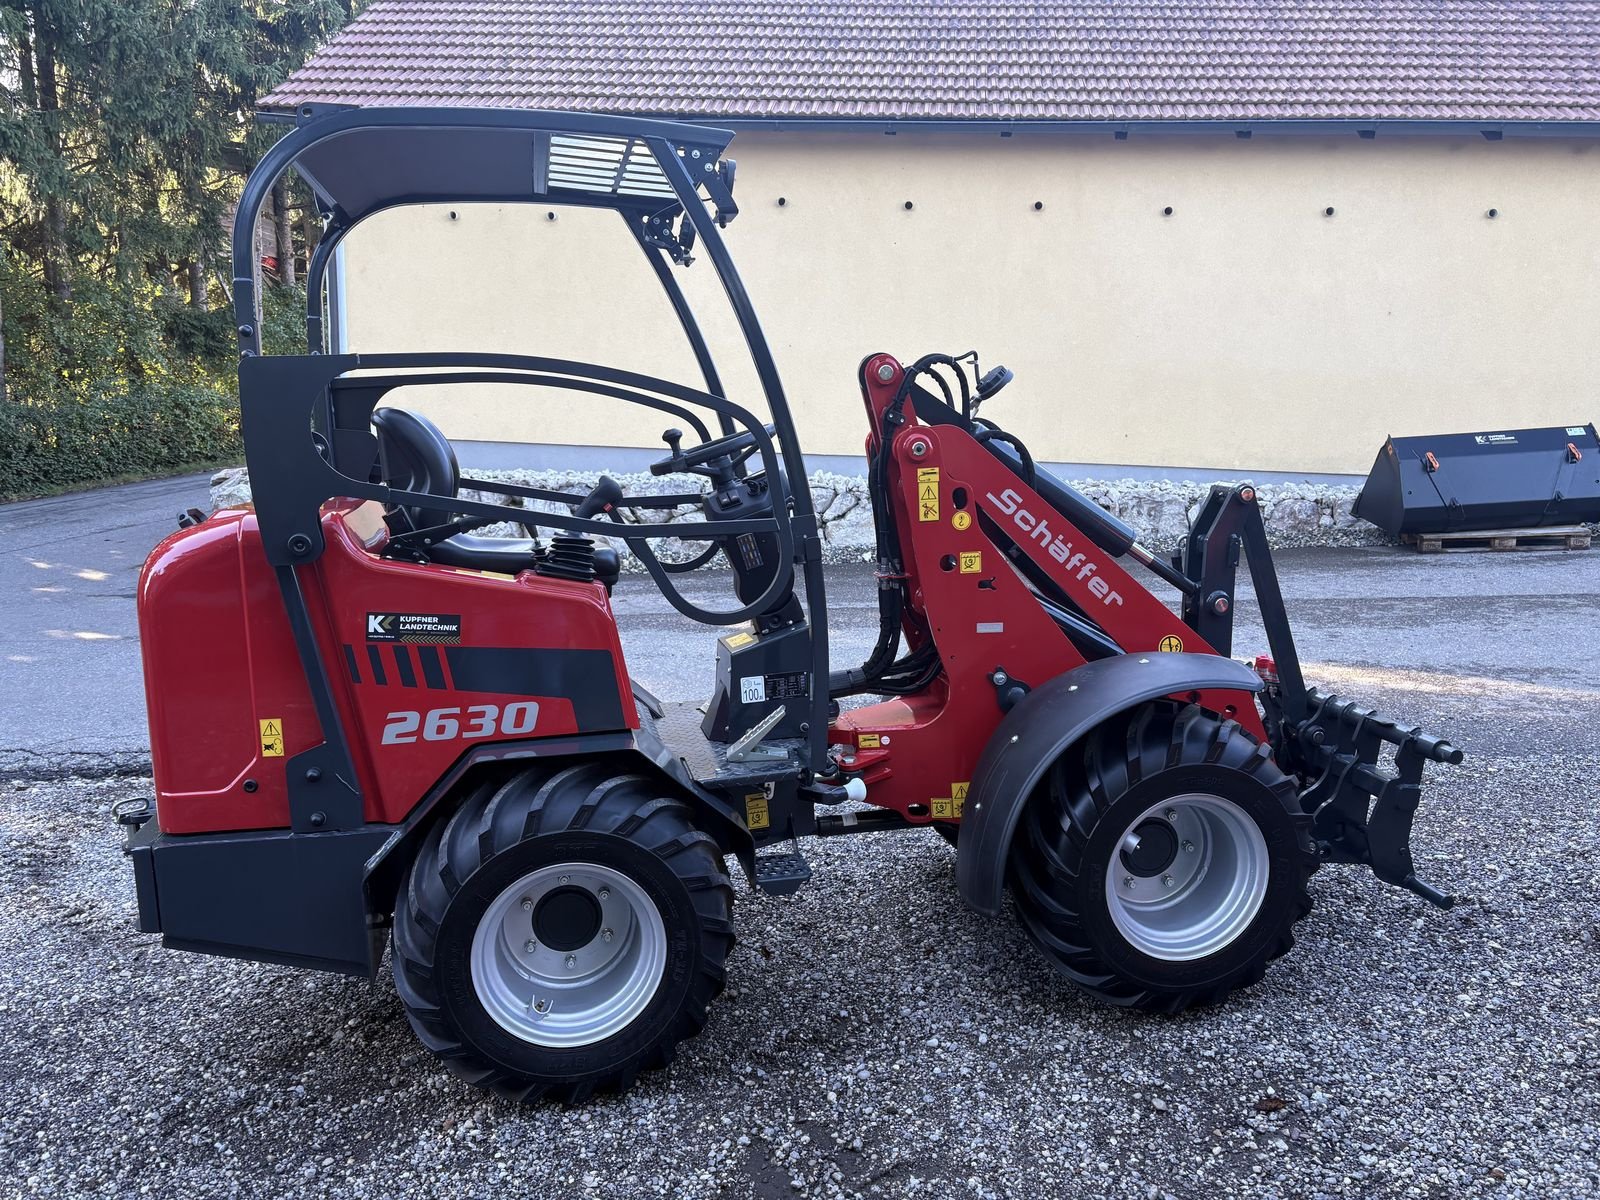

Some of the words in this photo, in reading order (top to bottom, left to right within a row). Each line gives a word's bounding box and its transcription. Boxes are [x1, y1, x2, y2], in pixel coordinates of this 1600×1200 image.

[986, 489, 1123, 606] Schäffer
[400, 623, 458, 631] LANDTECHNIK
[744, 689, 759, 701] 100
[381, 701, 540, 745] 2630
